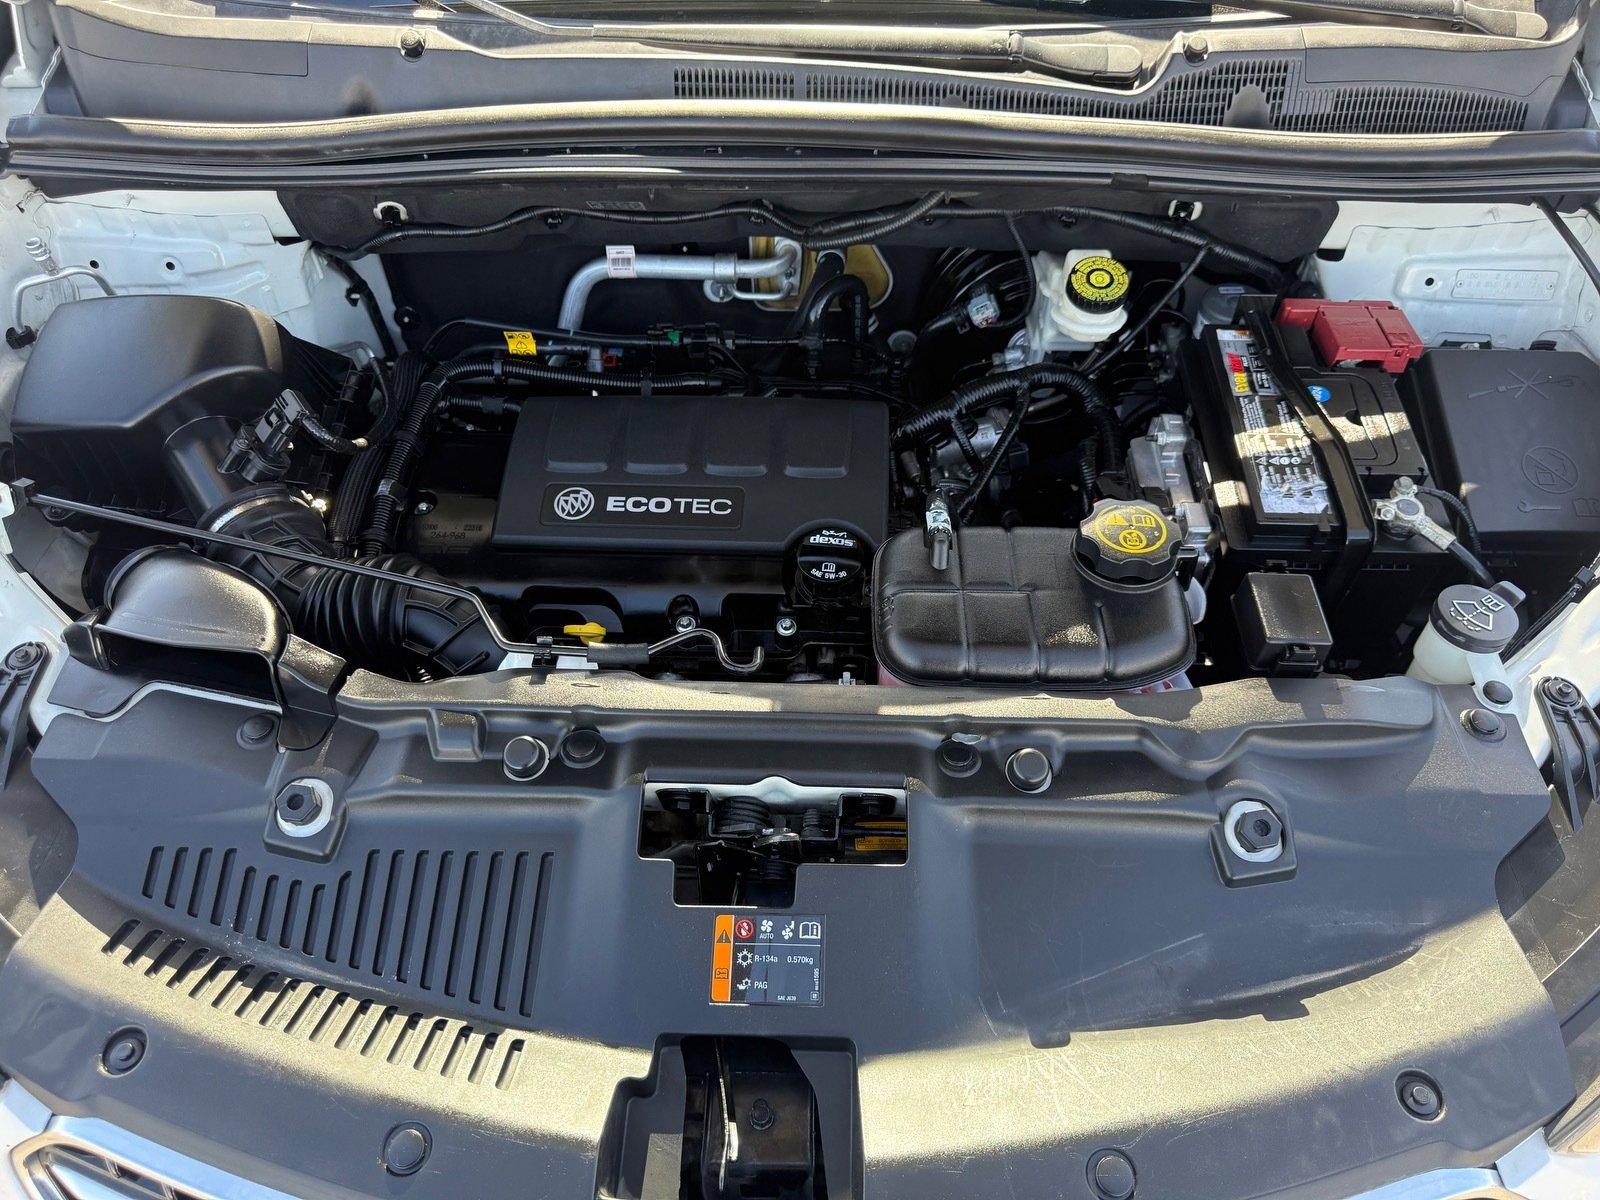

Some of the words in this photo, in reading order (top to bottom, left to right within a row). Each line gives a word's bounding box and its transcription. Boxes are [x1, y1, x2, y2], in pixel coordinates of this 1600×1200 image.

[606, 495, 733, 515] ECOTEC
[809, 534, 854, 547] dexos
[810, 568, 823, 578] SAE
[825, 571, 847, 579] 5W-30
[754, 955, 778, 963] R-134a
[787, 955, 814, 965] 0.570kg
[754, 981, 768, 989] PAG
